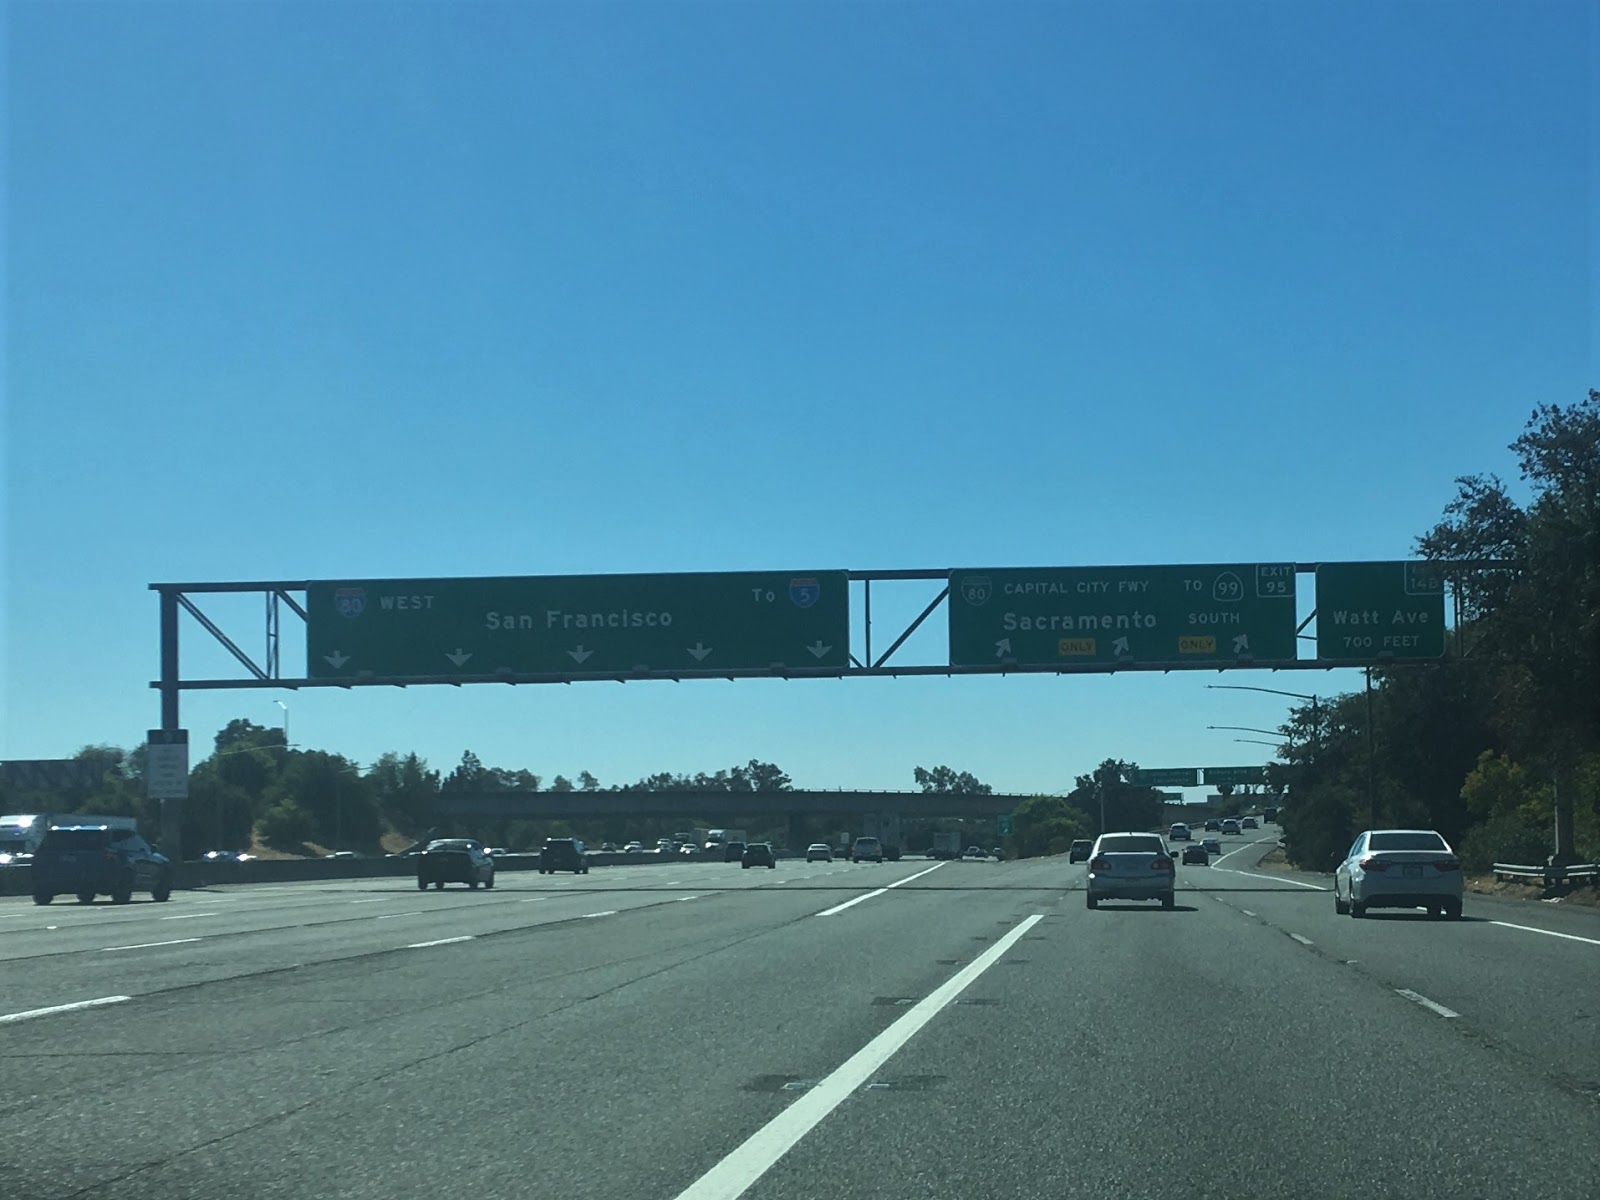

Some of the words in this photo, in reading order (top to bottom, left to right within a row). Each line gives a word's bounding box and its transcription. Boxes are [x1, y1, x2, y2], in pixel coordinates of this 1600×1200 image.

[1261, 566, 1291, 577] EXIT
[967, 588, 985, 600] 80
[1003, 582, 1068, 594] CAPITAL
[1076, 581, 1110, 593] CITY
[1118, 580, 1149, 592] FWY
[1183, 579, 1203, 592] TO
[1218, 581, 1239, 596] 99
[1266, 581, 1287, 593] 95
[800, 588, 810, 602] 5
[341, 598, 361, 612] 80
[379, 595, 435, 610] WEST
[485, 611, 534, 630] San
[546, 608, 673, 629] Francisco
[1003, 610, 1157, 631] Sacramento
[1188, 612, 1241, 625] SOUTH
[1332, 610, 1379, 625] Watt
[1391, 610, 1429, 625] Ave
[1060, 641, 1093, 652] ONLY
[1180, 640, 1214, 650] ONLY
[1342, 635, 1373, 648] 700
[1383, 635, 1420, 648] FEET
